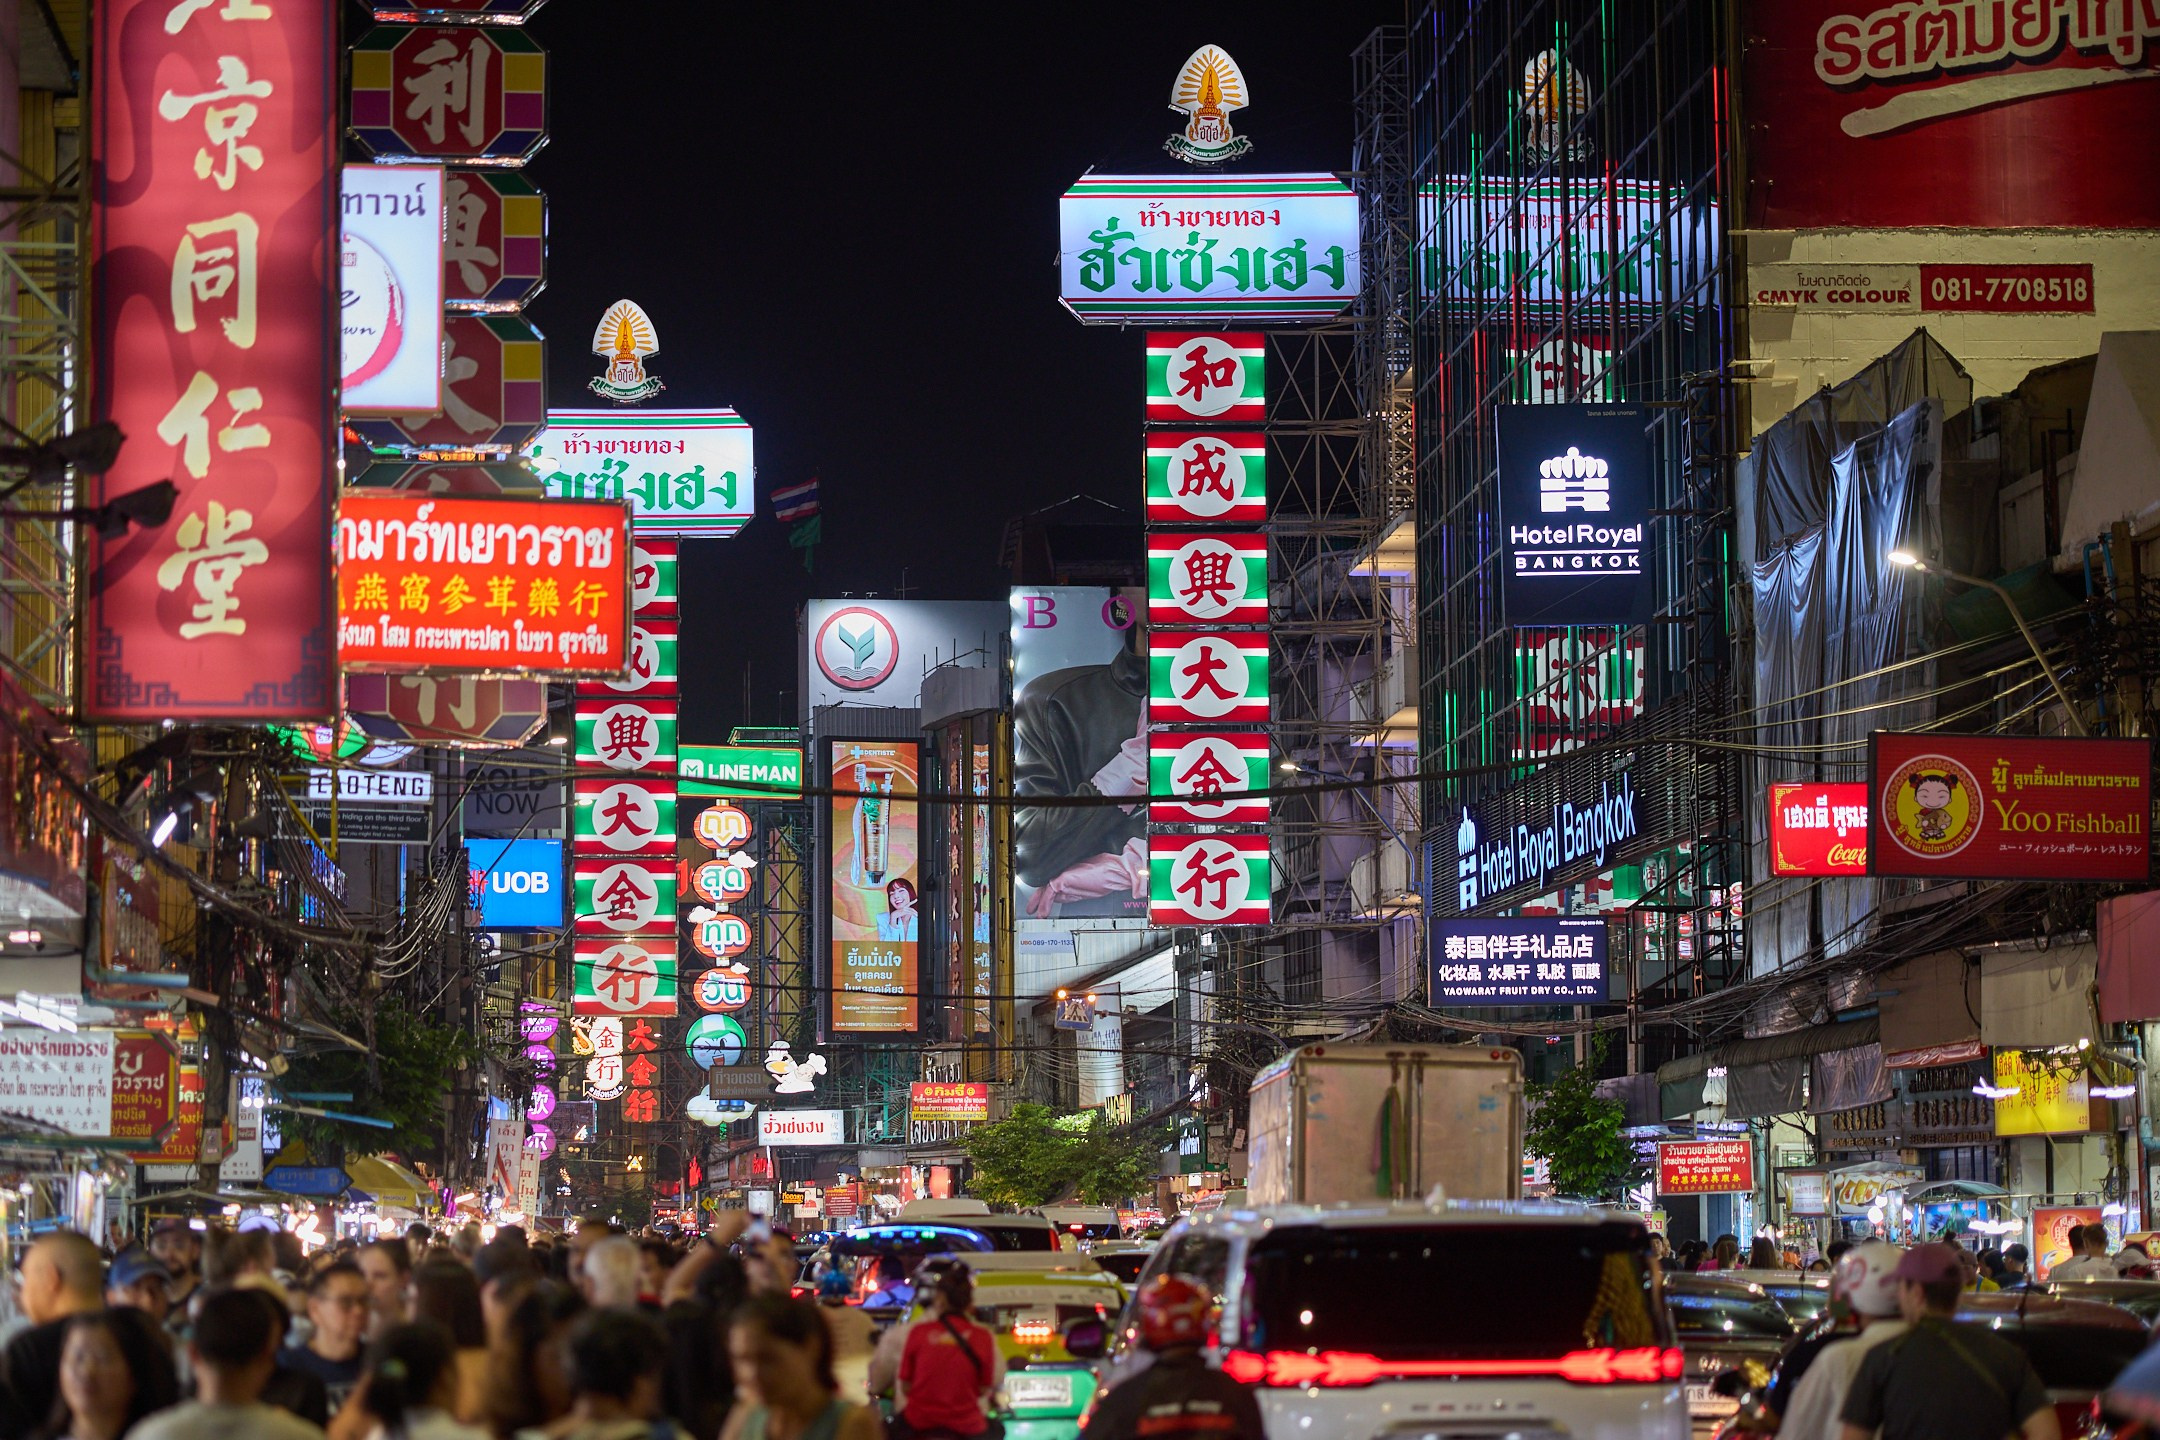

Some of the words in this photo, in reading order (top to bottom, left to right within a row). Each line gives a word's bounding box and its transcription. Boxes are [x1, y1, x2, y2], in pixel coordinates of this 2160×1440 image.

[1139, 202, 1281, 227] ห้างขายทอง
[1077, 216, 1346, 293] ฮั่วเซ่งเฮง
[1757, 290, 1820, 304] CMYK
[1827, 290, 1911, 304] COLOUR
[1931, 278, 2088, 302] 081-7708518
[563, 432, 685, 455] ห้างขายทอง
[1511, 526, 1573, 545] Hotel
[1577, 524, 1642, 547] Royal
[1515, 555, 1640, 569] BANGKOK
[415, 625, 510, 652] กระเพาะปลา
[513, 619, 553, 653] ใบชา
[558, 624, 609, 664] สุราจีน
[466, 768, 549, 791] GOLD
[708, 764, 750, 780] LINE
[752, 765, 797, 782] MAN
[476, 793, 540, 814] NOW
[1784, 794, 1830, 829] เฮงดี
[2056, 812, 2142, 834] Fishball
[1480, 827, 1516, 899] Hotel
[1518, 805, 1560, 890] Royal
[1562, 772, 1637, 867] Bangkok
[493, 871, 550, 893] UOB
[848, 947, 902, 967] ยิ้มมั่นใจ
[1444, 934, 1594, 960] 泰国伴手礼品店
[854, 972, 893, 982] ดูแลครบ
[1439, 964, 1482, 981] 化妆品
[1487, 964, 1531, 981] 水果干
[1537, 963, 1566, 981] 乳胶
[1572, 963, 1601, 980] 面膜
[1443, 986, 1497, 996] YAOWARAT
[1500, 986, 1529, 995] FRUIT
[1531, 986, 1551, 995] DRY
[1554, 985, 1574, 996] CO.,
[1576, 985, 1597, 995] LTD.
[594, 1026, 619, 1080] 金行
[624, 1018, 658, 1122] 大金行
